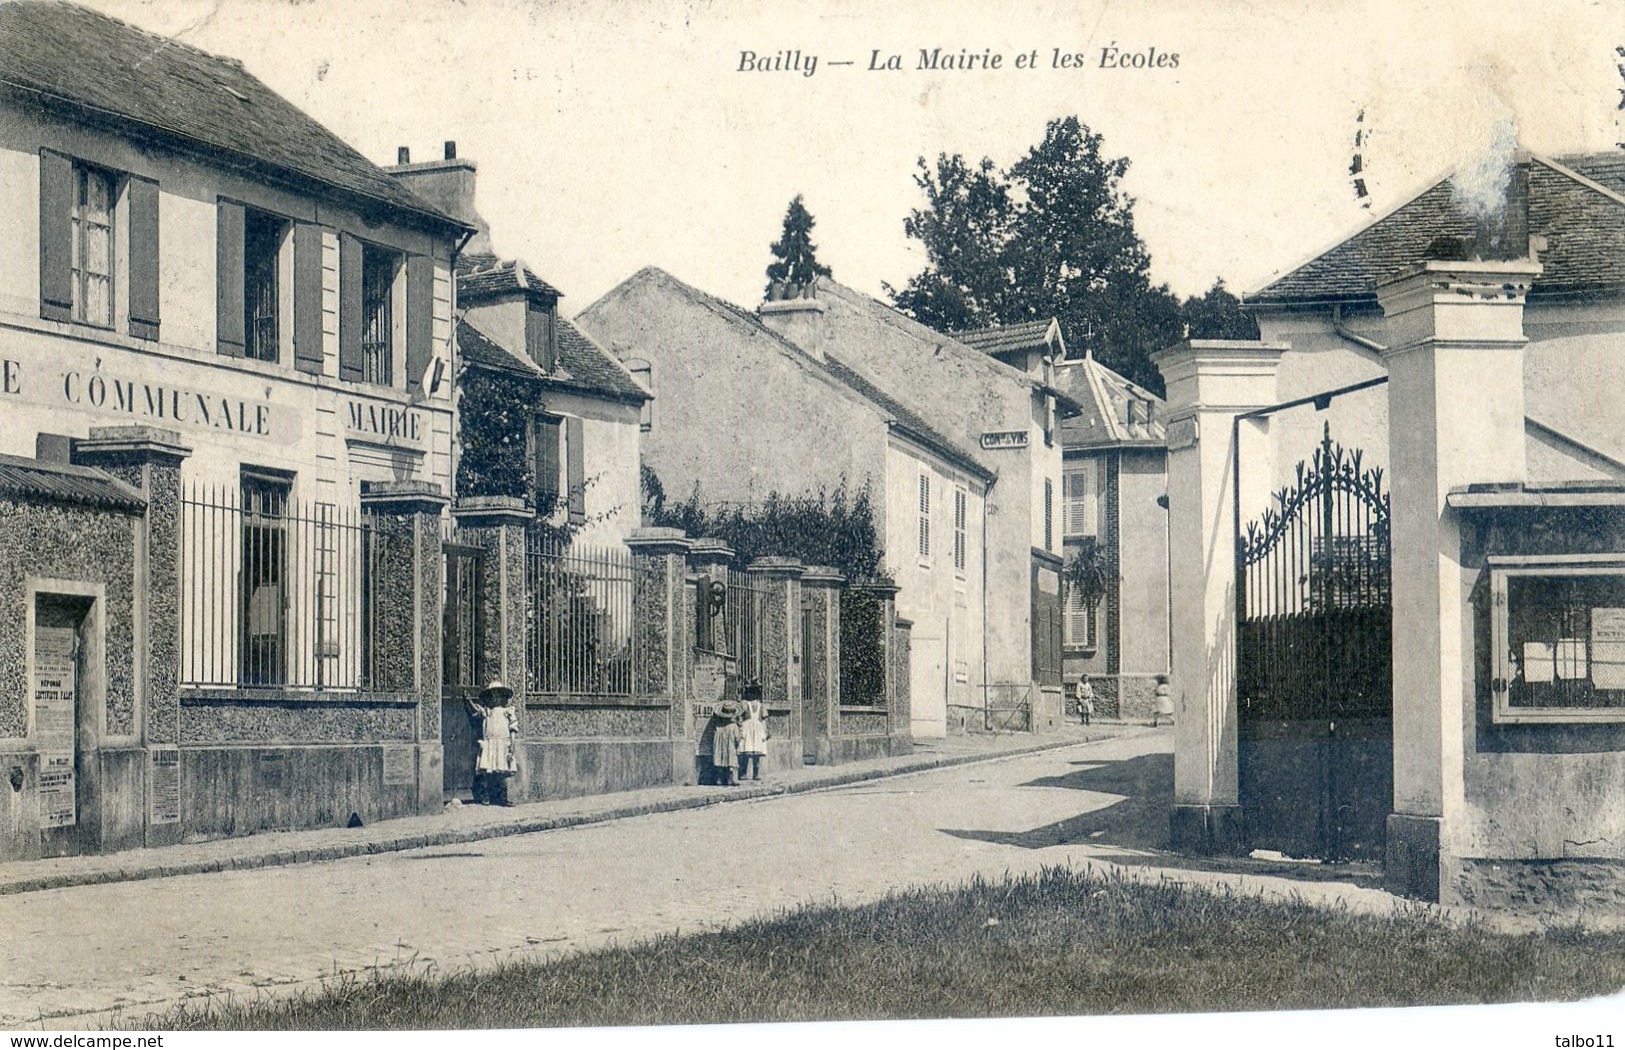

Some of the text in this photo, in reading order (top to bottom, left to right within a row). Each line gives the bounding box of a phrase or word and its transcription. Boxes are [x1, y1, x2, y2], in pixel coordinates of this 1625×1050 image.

[63, 370, 271, 437] COMMUNALE
[346, 401, 422, 441] MAIRIE
[1011, 431, 1028, 445] VINS
